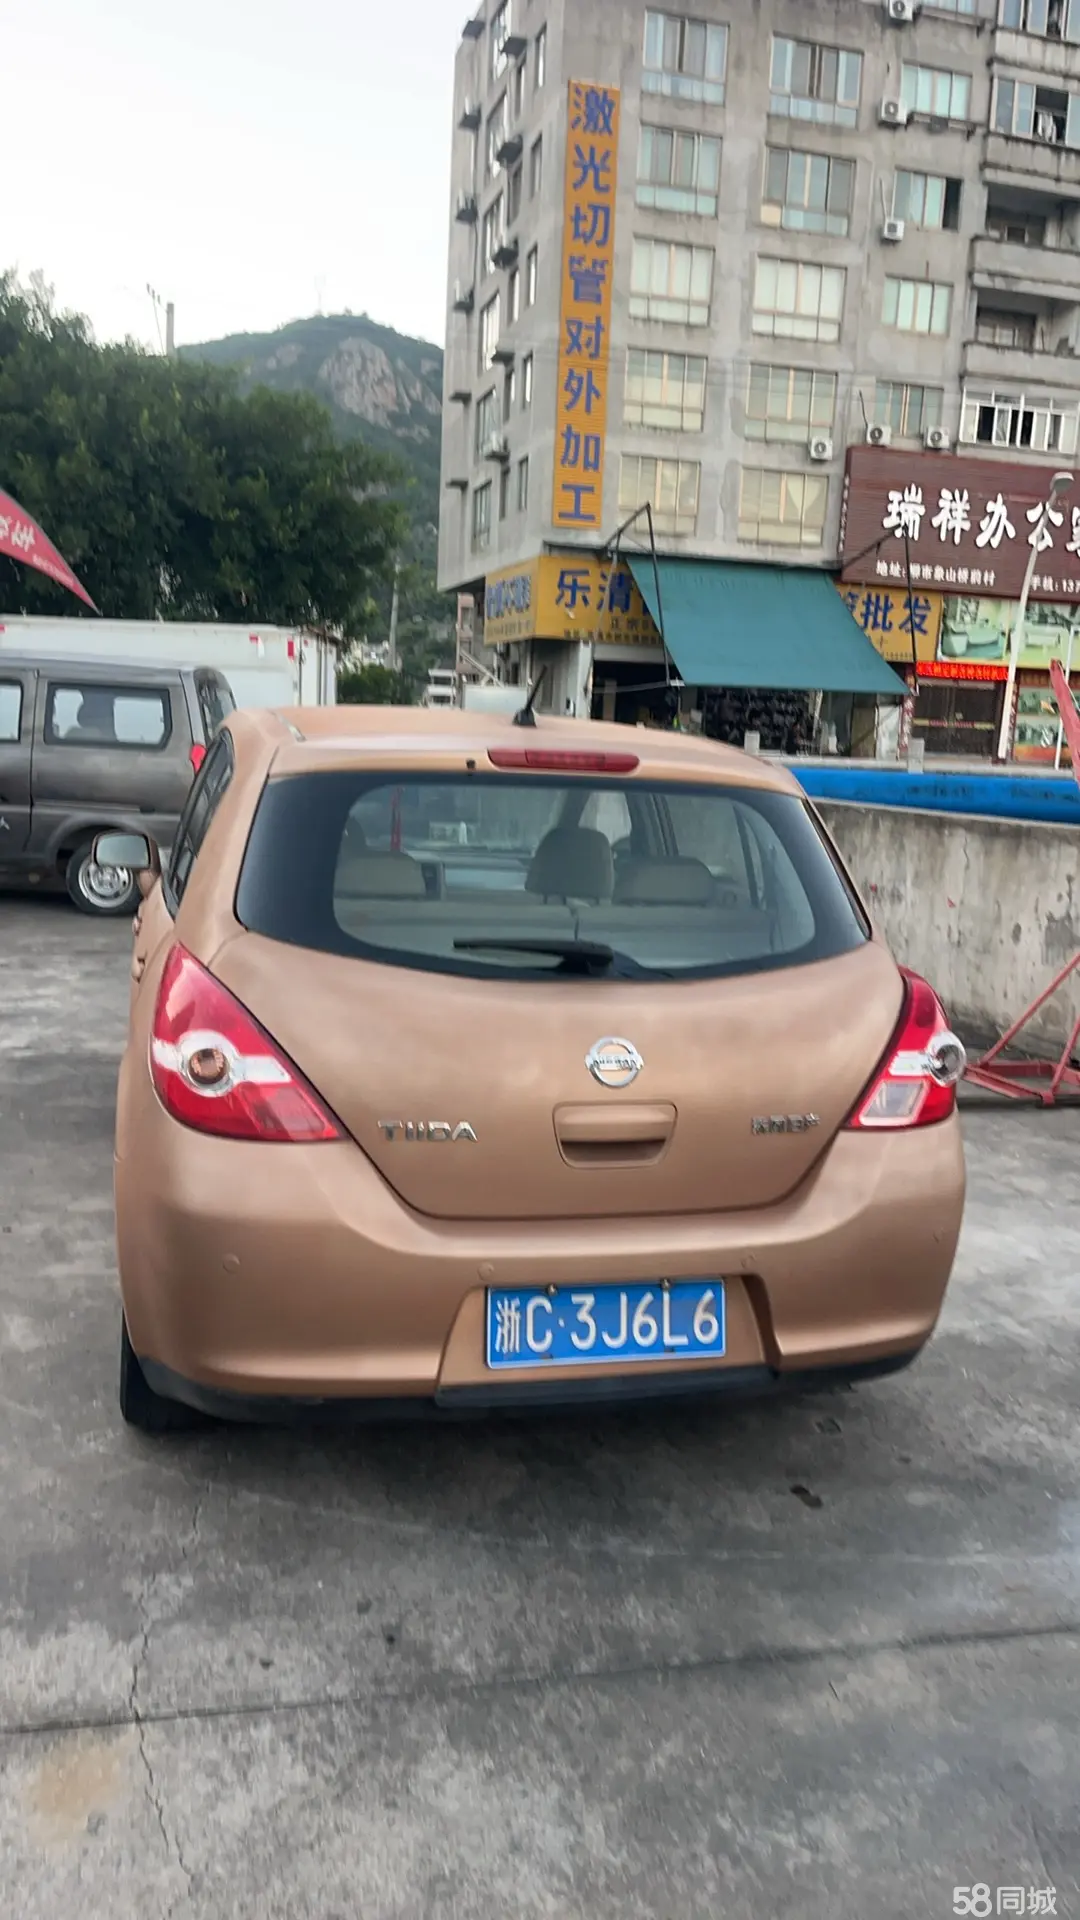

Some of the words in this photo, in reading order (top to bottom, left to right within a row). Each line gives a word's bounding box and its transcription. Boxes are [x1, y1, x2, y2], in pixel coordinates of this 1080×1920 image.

[558, 86, 615, 521] 激光切管对外加工
[555, 567, 650, 615] 乐清
[377, 1119, 478, 1142] TIIDA
